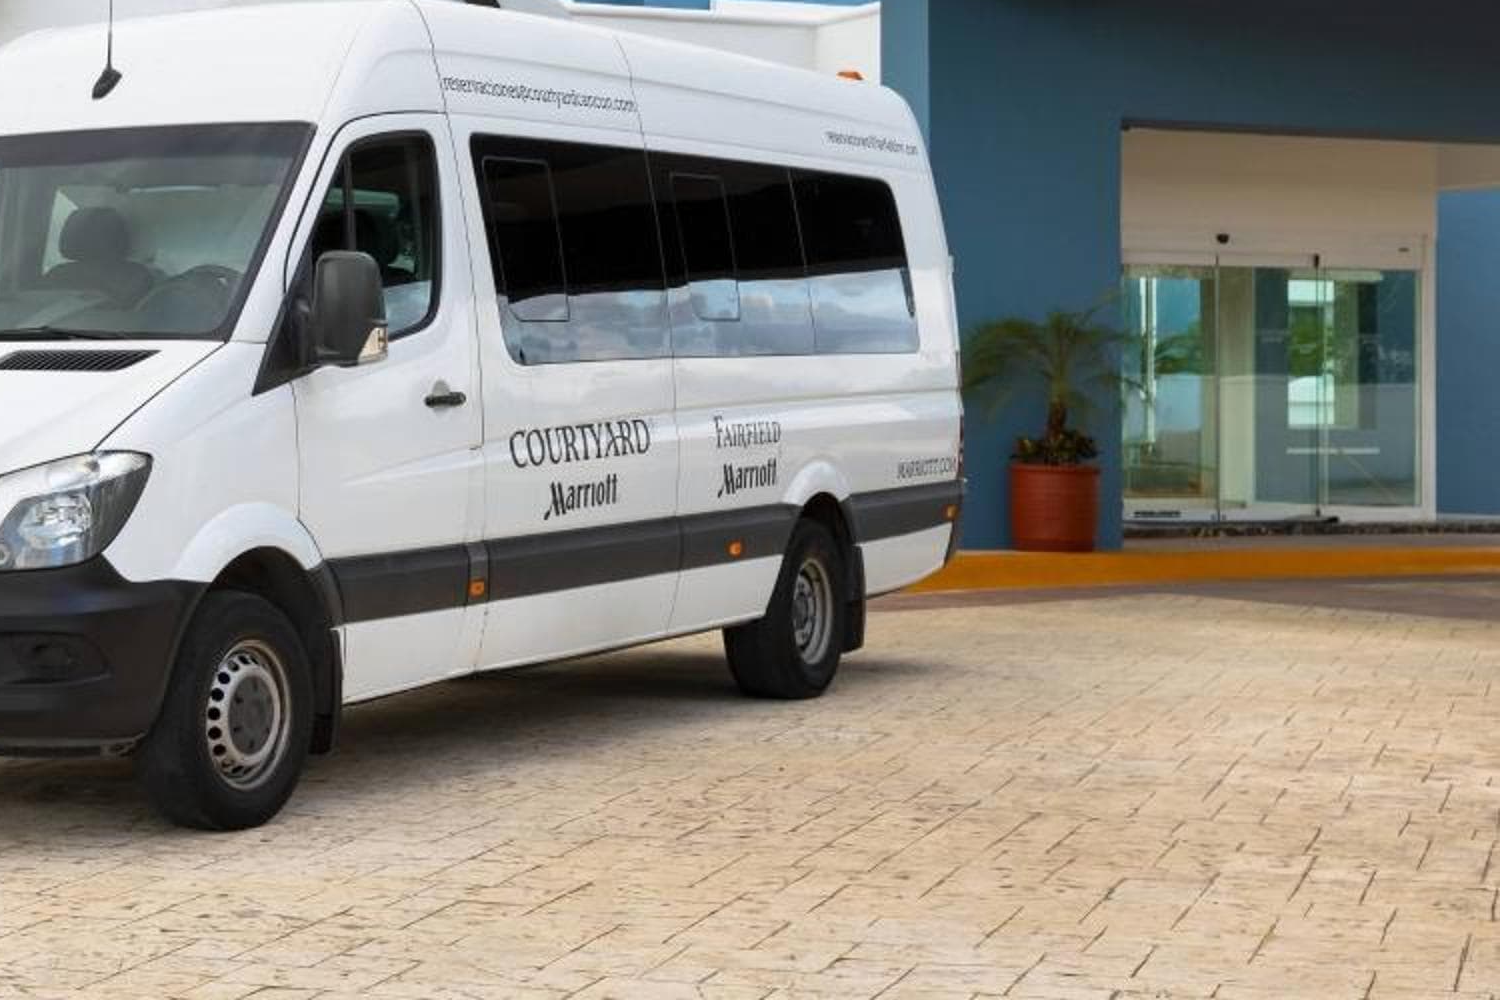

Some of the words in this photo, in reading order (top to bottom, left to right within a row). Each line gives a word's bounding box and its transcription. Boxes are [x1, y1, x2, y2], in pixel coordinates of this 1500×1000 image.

[509, 418, 650, 468] COURTYARD
[543, 473, 618, 521] Marriott
[717, 457, 777, 499] Marriott
